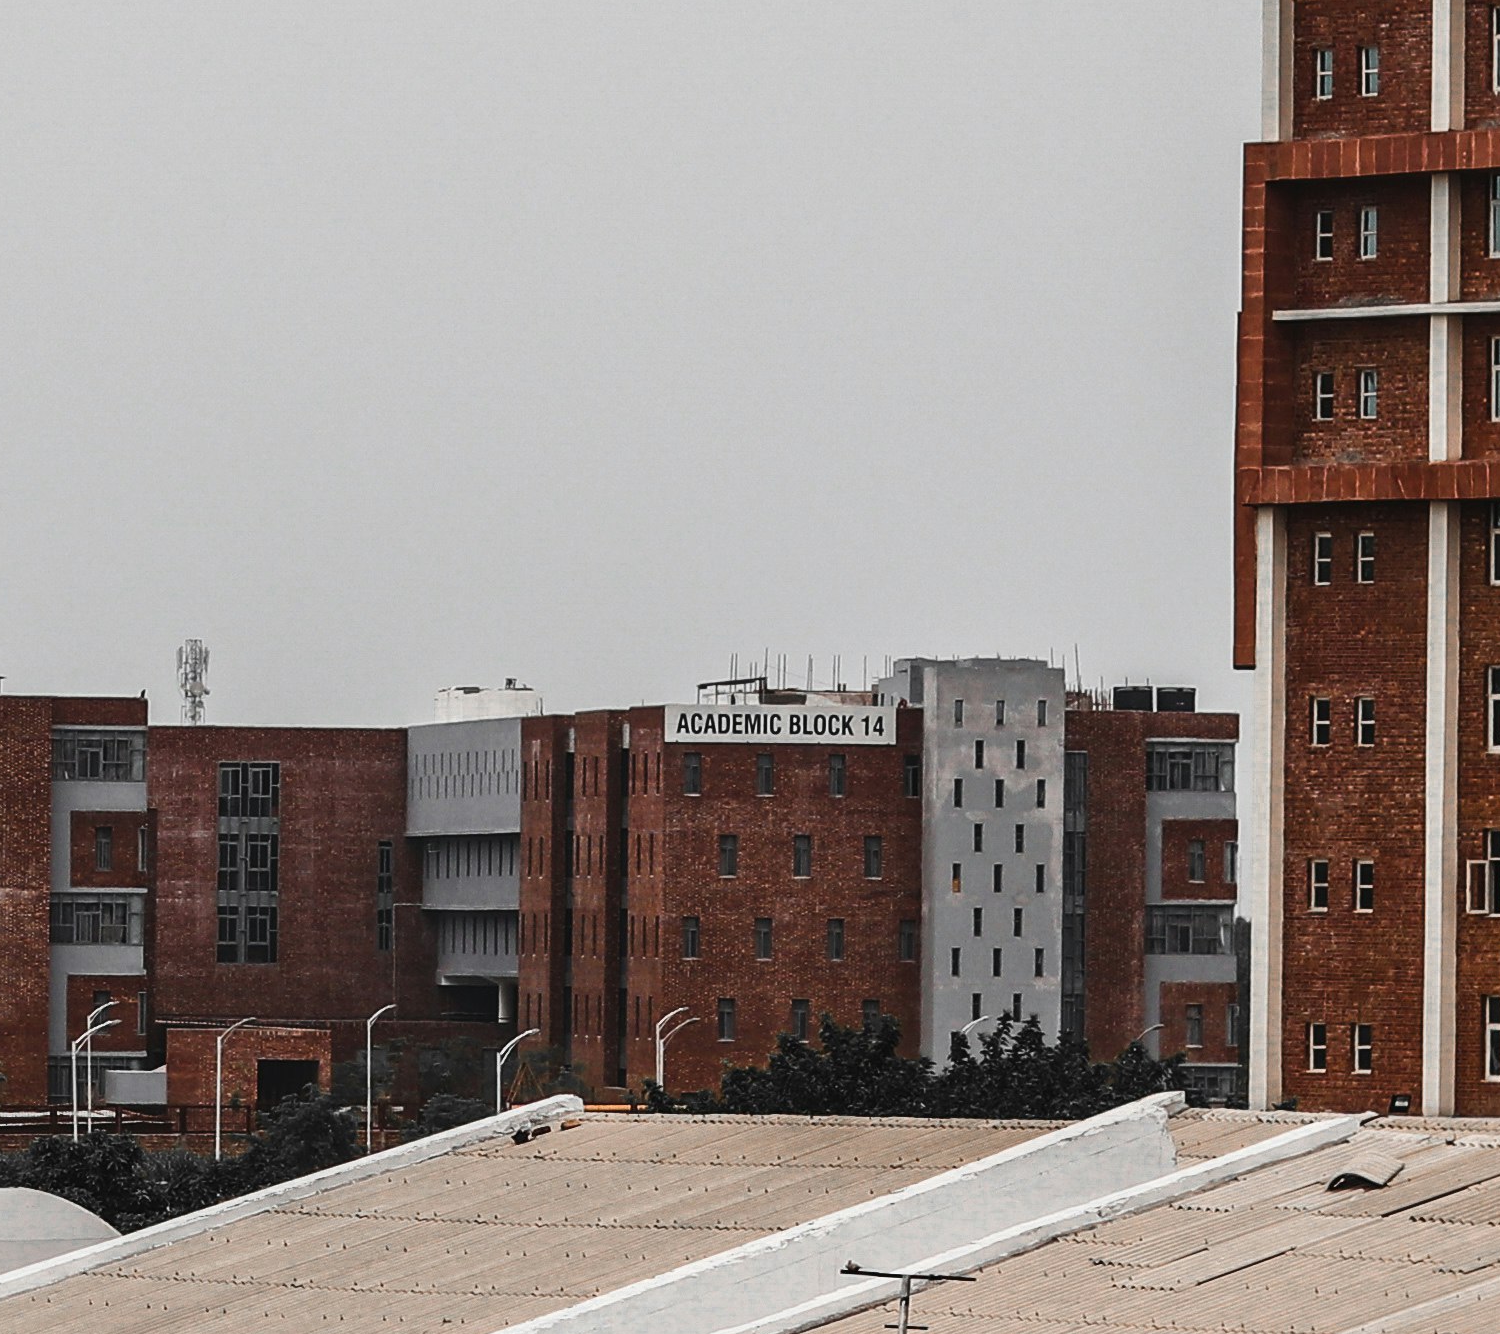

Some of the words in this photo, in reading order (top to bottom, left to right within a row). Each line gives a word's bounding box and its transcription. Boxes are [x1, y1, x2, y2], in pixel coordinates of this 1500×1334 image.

[676, 712, 782, 735] ACADEMIC
[789, 714, 854, 736] BLOCK
[861, 715, 885, 736] 14
